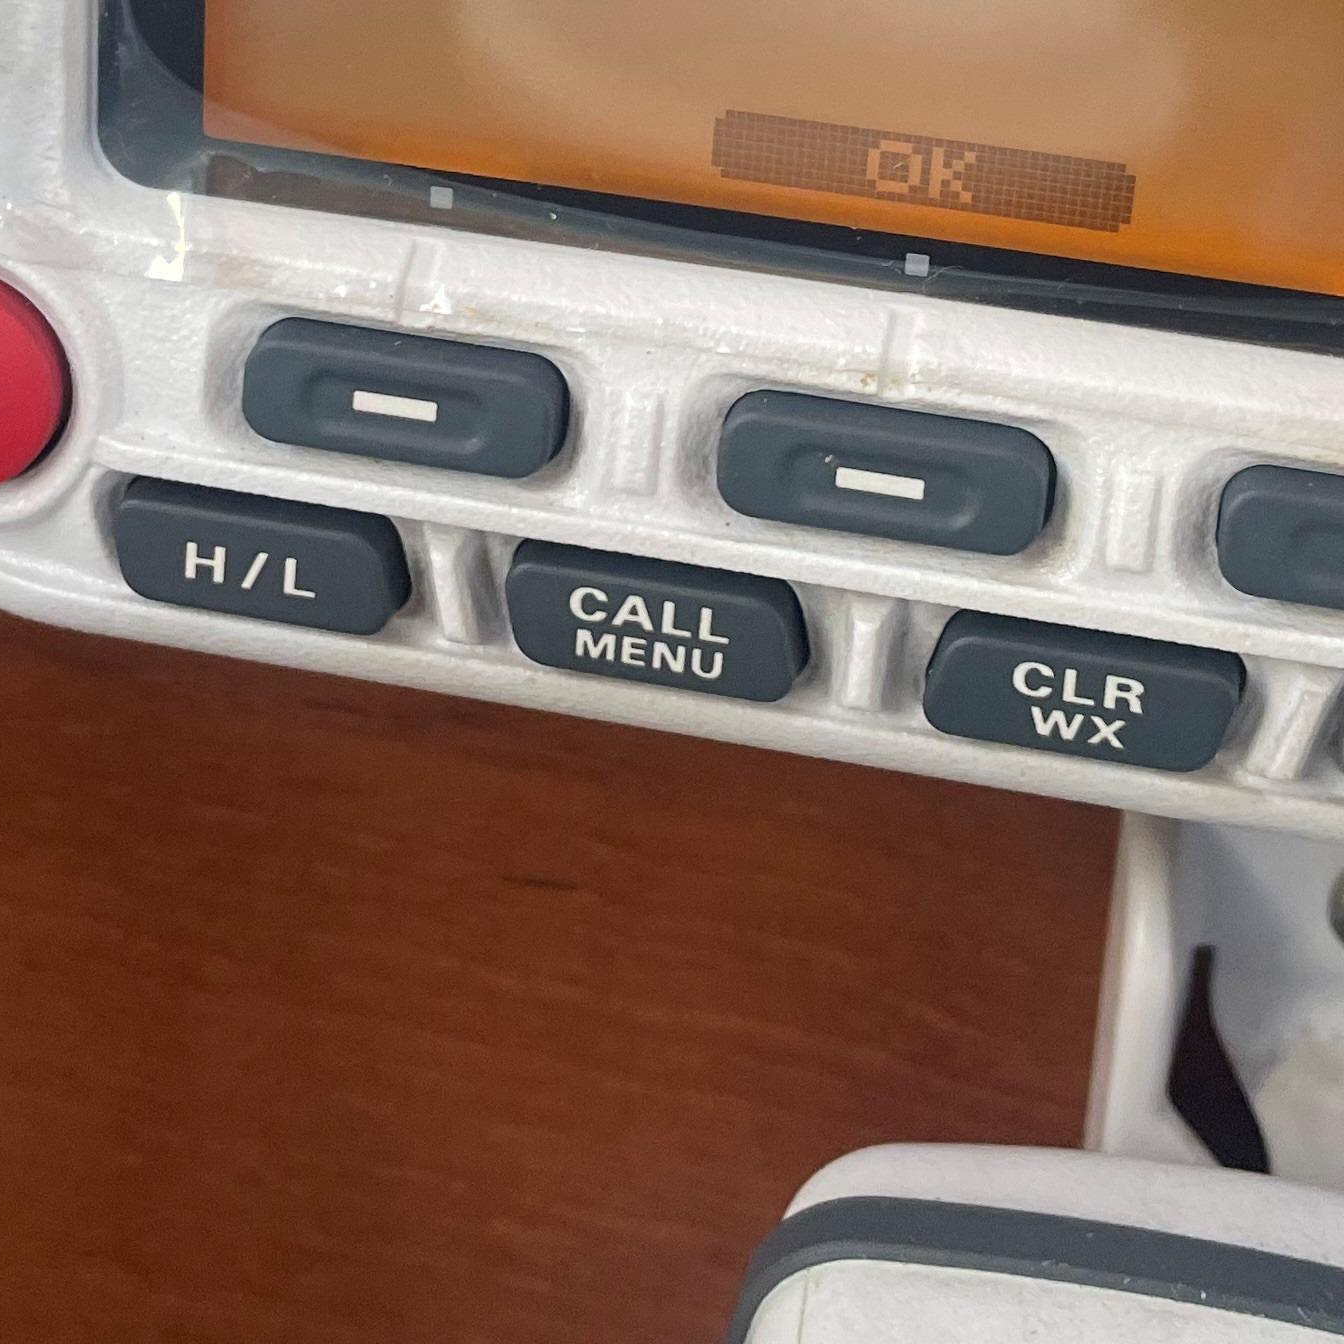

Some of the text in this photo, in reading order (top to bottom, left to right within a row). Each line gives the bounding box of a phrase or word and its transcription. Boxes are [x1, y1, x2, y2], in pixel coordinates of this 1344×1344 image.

[866, 139, 977, 205] OK
[183, 540, 316, 599] H/L
[569, 585, 731, 646] CALL
[574, 629, 726, 681] MENU
[1011, 660, 1147, 715] CLR
[1029, 707, 1128, 750] WX
